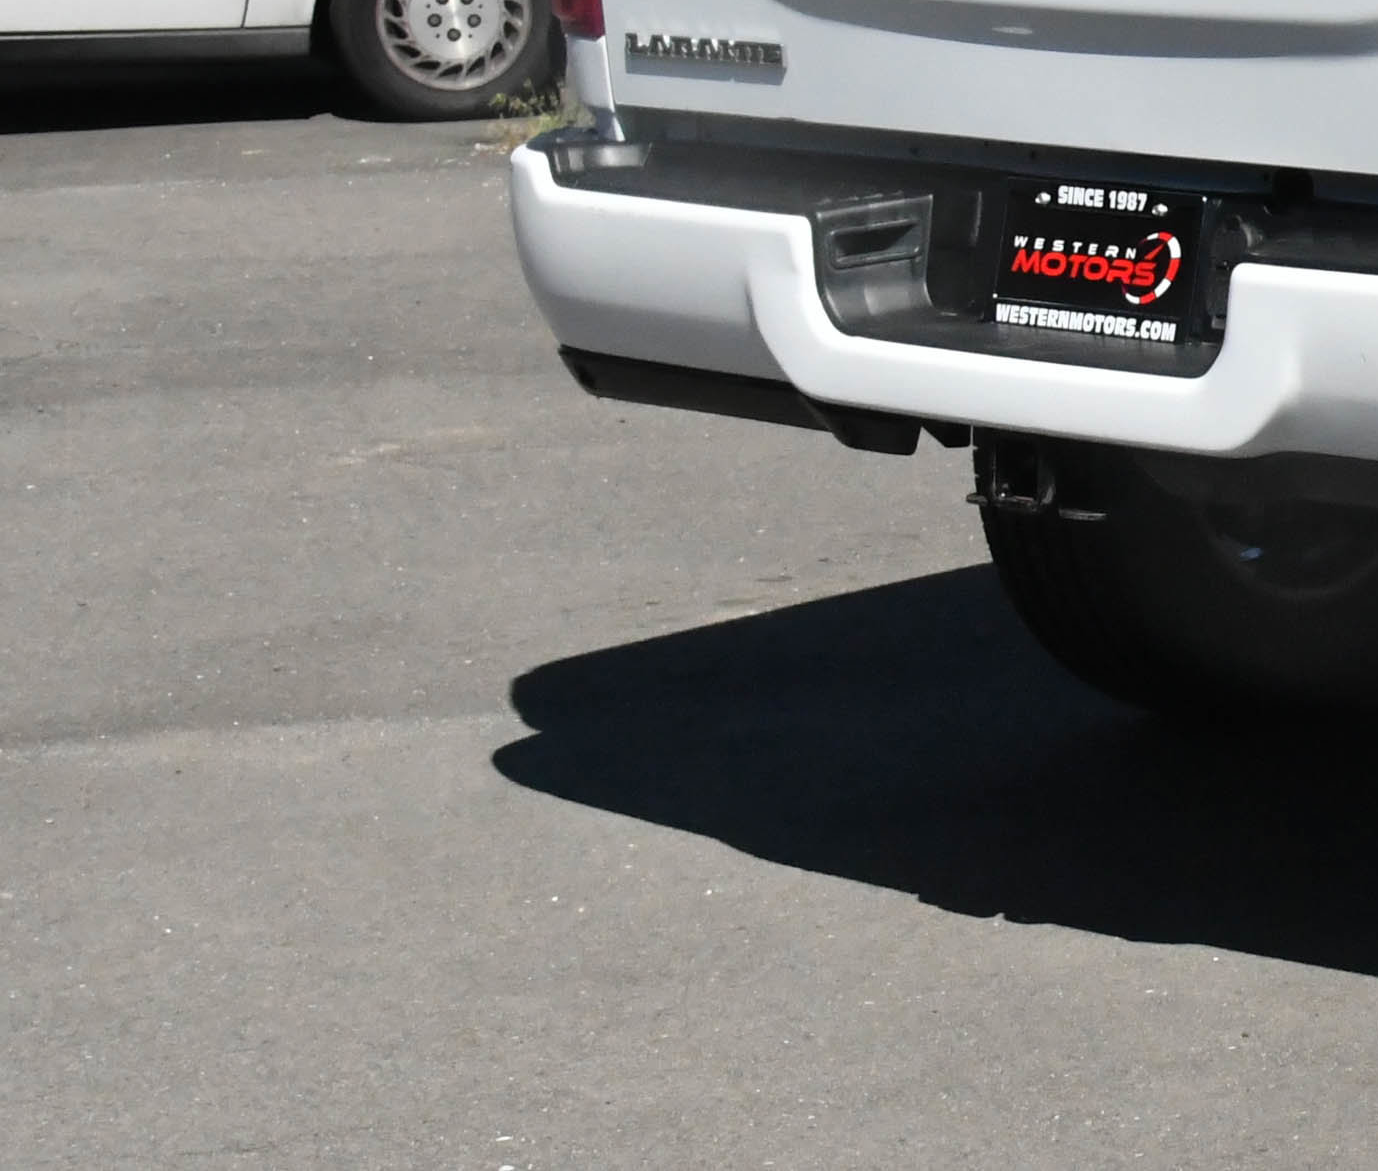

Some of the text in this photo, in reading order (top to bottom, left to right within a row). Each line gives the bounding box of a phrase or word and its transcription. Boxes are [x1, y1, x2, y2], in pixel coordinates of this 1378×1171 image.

[1057, 185, 1148, 212] SINCE 1987
[1013, 235, 1137, 260] WESTERN
[1011, 248, 1157, 287] MOTORS
[995, 303, 1177, 342] WESTERNMOTORS.COM
